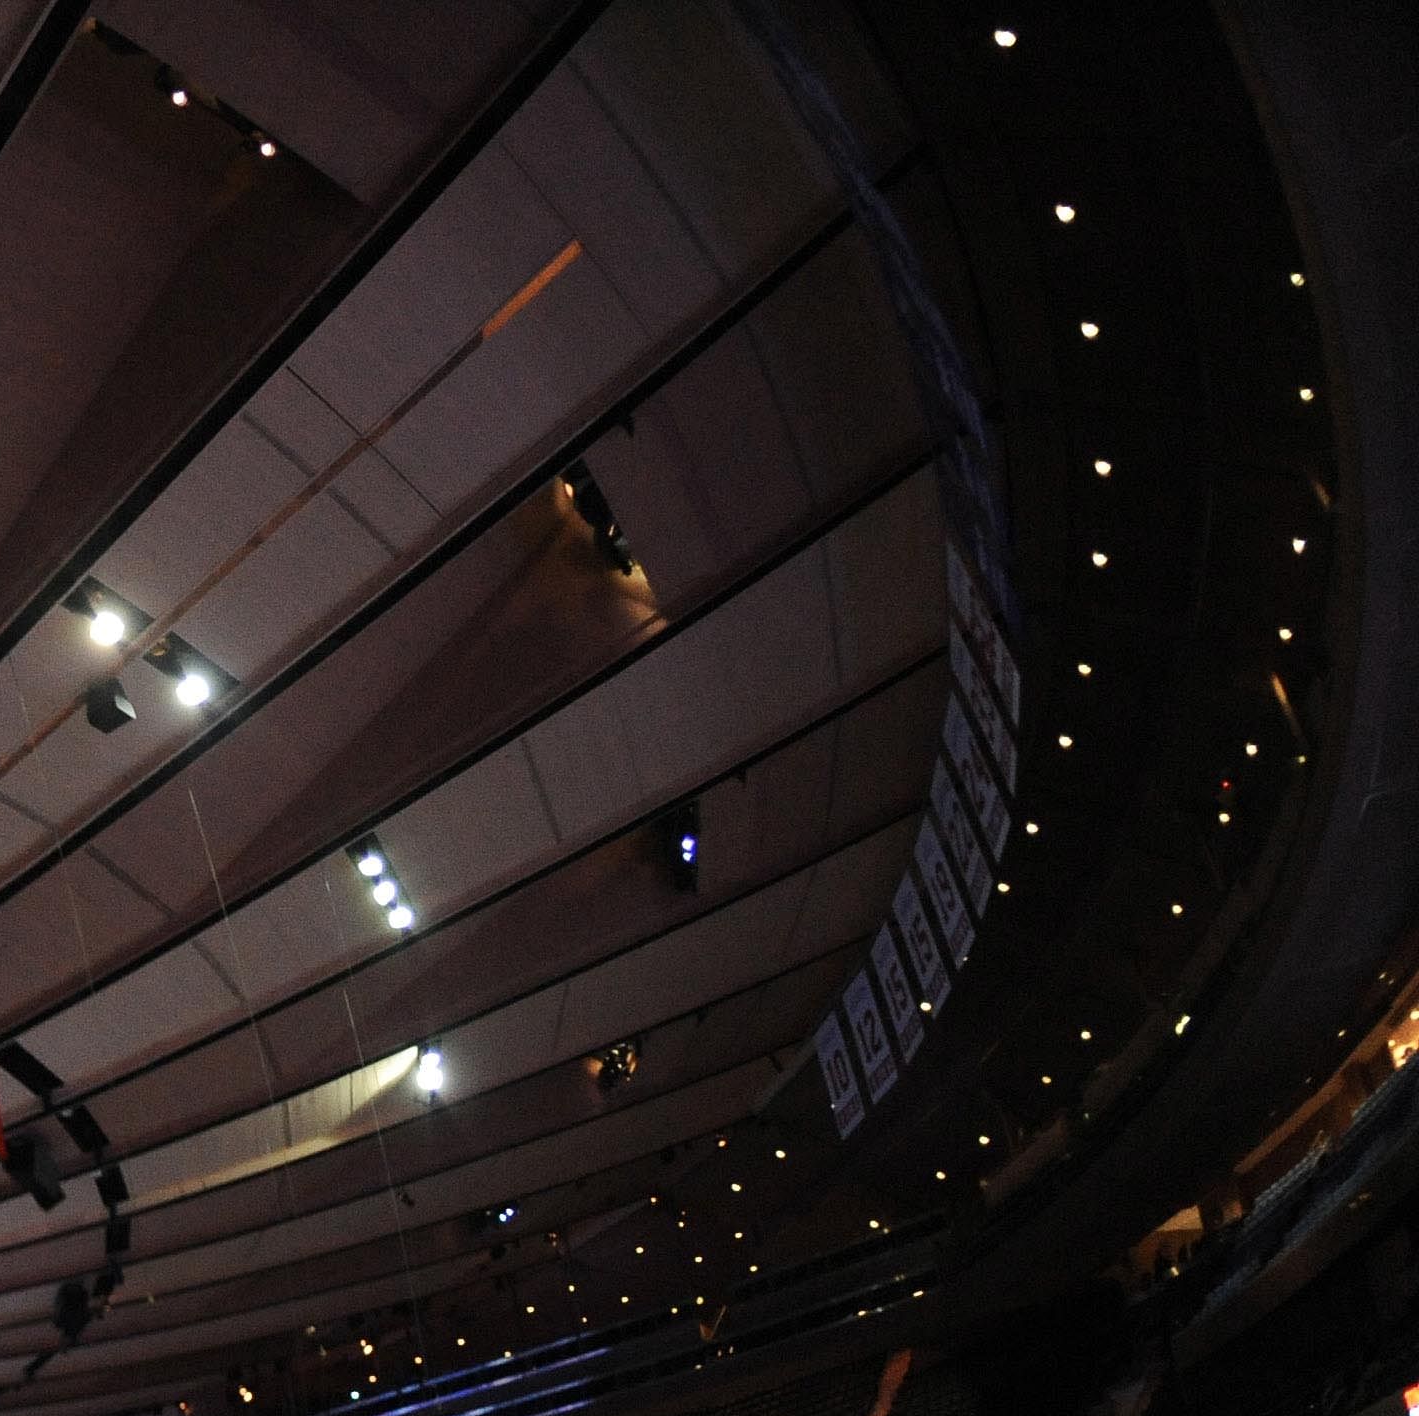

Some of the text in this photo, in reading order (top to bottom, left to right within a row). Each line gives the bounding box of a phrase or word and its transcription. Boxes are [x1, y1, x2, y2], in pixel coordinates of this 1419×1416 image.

[909, 914, 933, 974] 15
[886, 960, 909, 1022] 15
[856, 1010, 882, 1063] 12
[826, 1049, 850, 1100] 10
